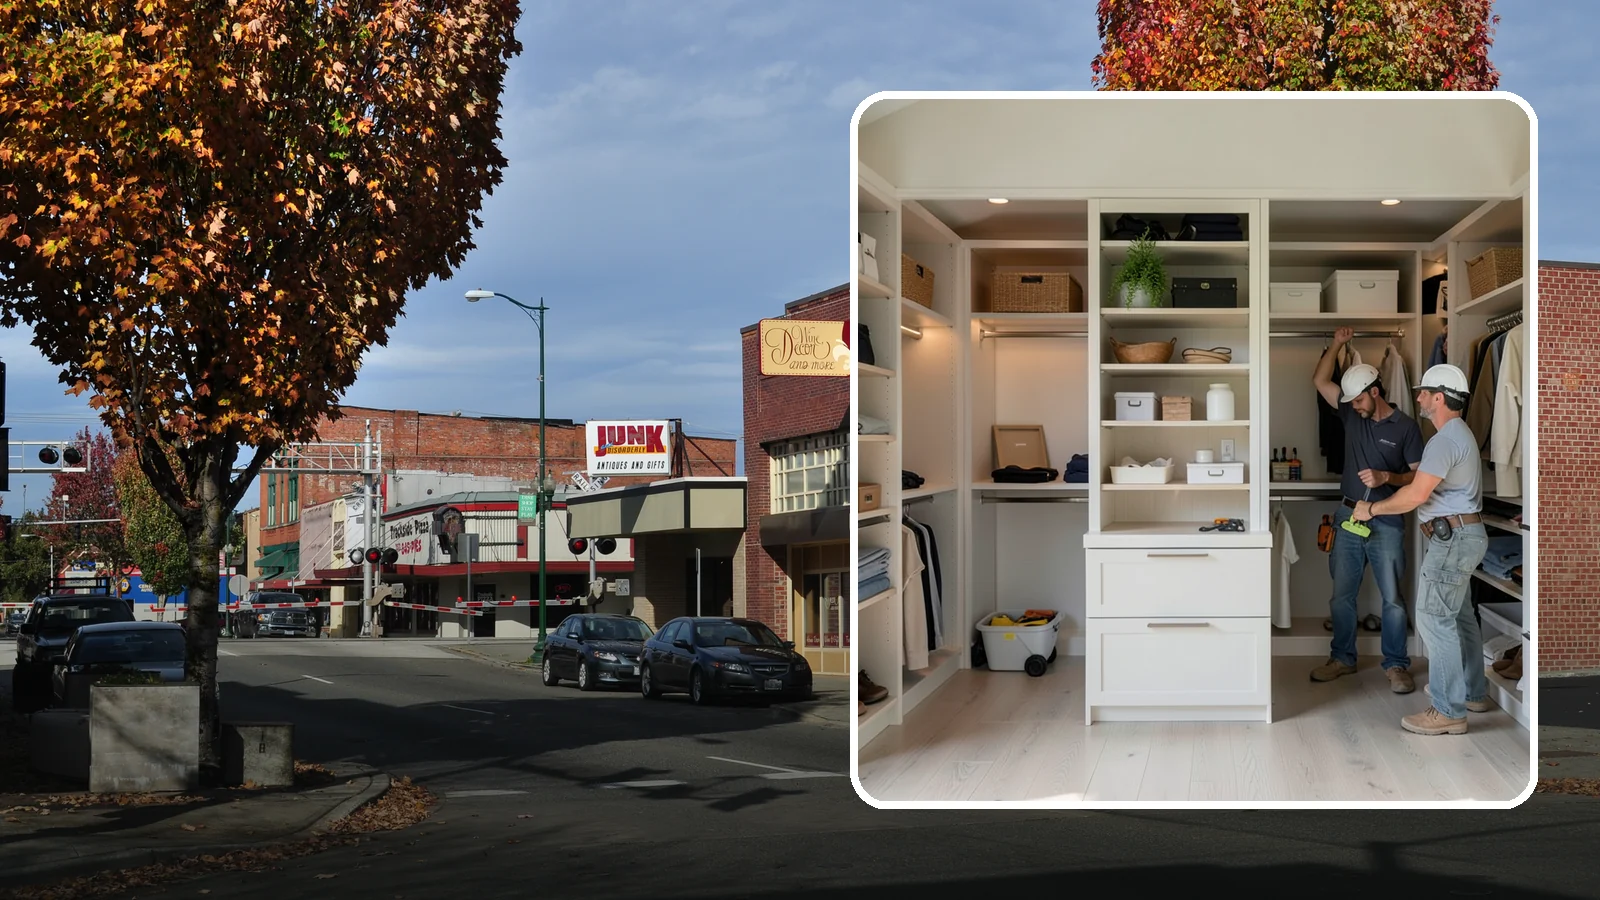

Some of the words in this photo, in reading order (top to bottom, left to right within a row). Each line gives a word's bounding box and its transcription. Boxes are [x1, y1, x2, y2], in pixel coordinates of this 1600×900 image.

[764, 327, 831, 365] Decor
[595, 425, 666, 457] JUNK
[607, 446, 645, 454] DISORDERLY
[597, 461, 628, 470] ANTIQUES
[631, 461, 644, 470] AND
[647, 460, 665, 470] GIFTS
[390, 521, 413, 539] Trackside
[414, 520, 429, 535] Pizza
